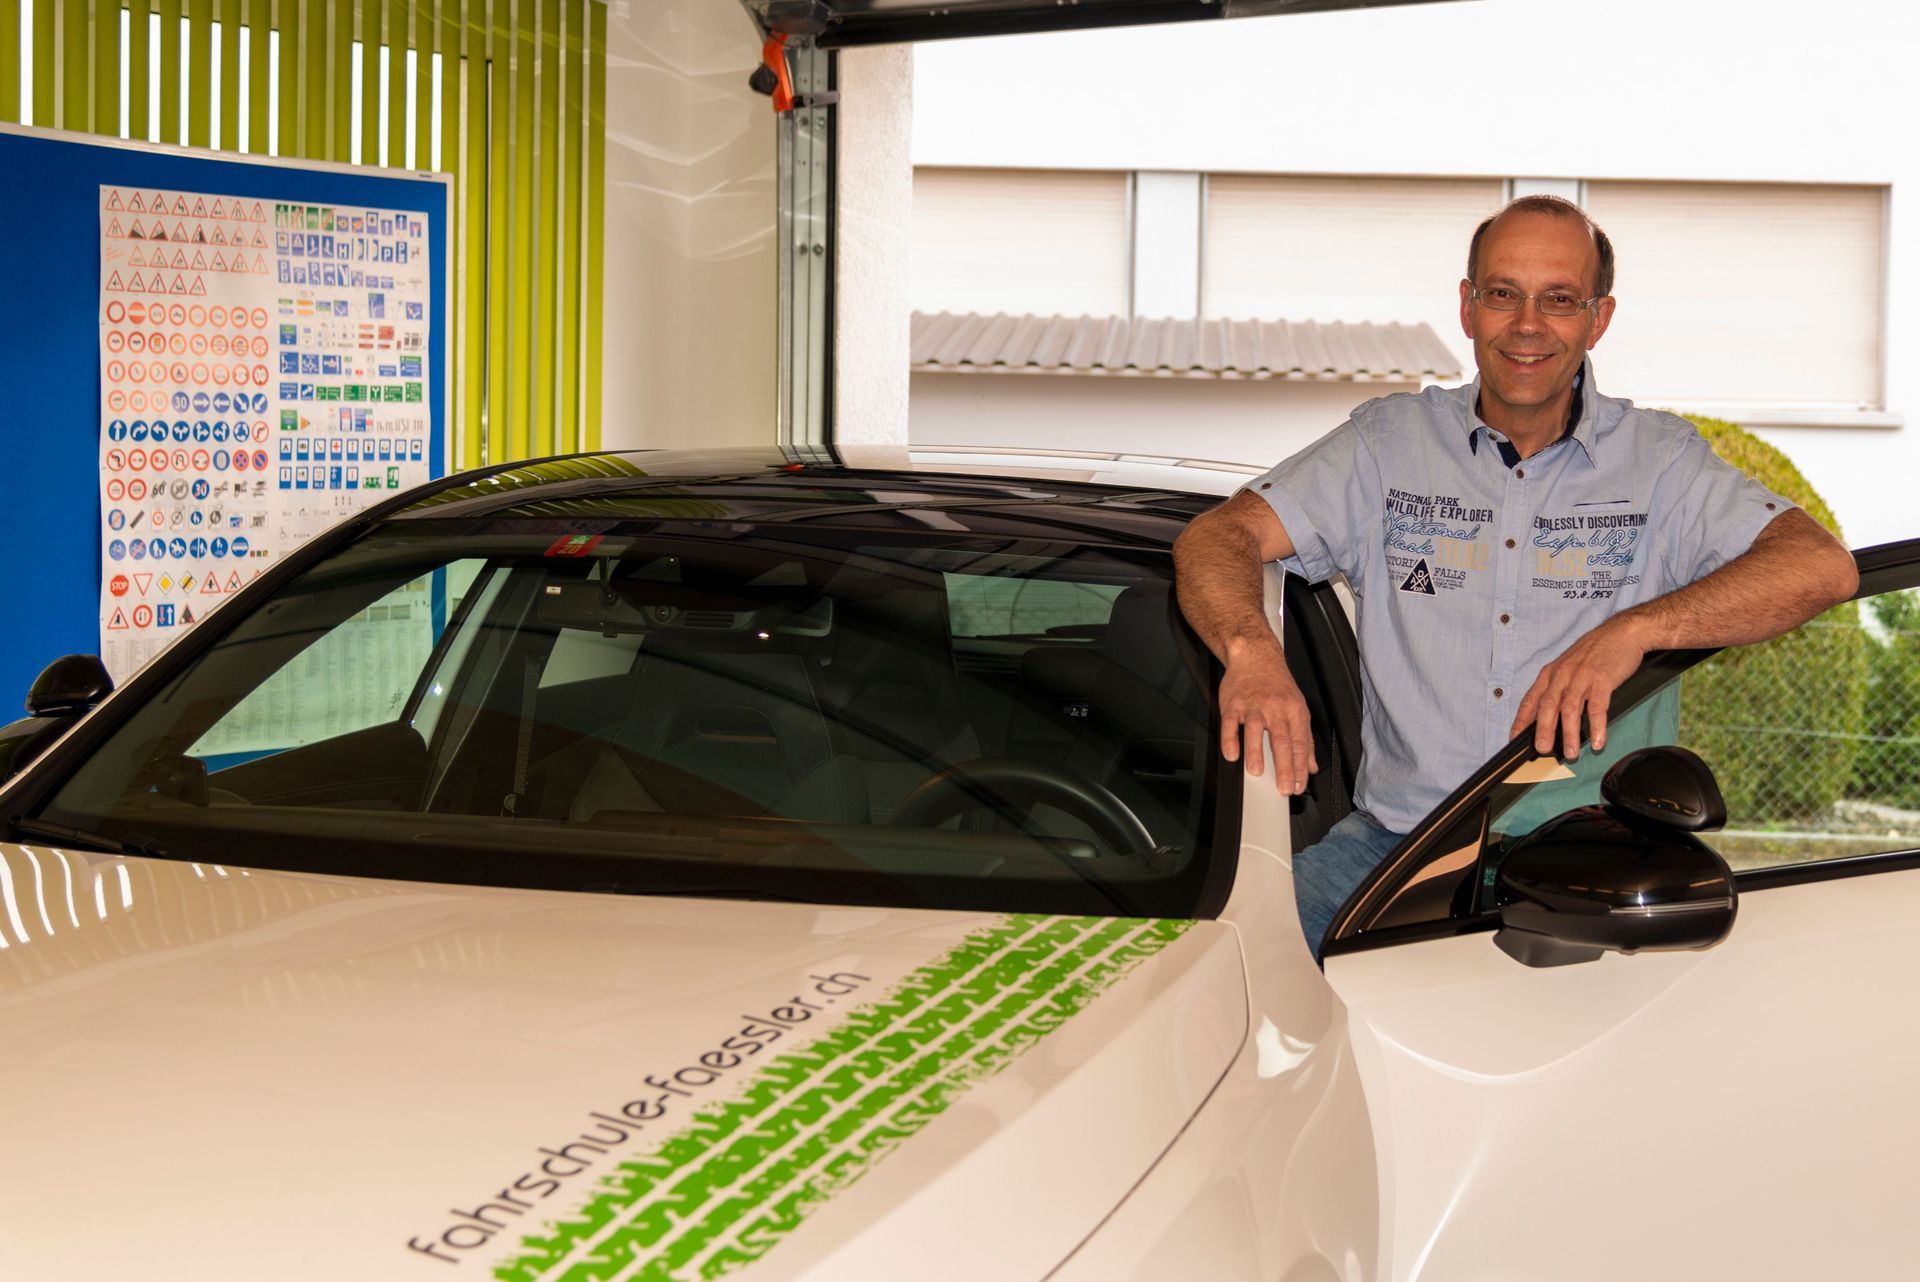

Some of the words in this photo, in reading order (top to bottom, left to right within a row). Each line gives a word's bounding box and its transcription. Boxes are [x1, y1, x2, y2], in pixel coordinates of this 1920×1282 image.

[339, 245, 349, 259] H
[384, 248, 391, 261] P
[174, 396, 188, 410] 30
[1388, 488, 1431, 506] NATIONAL
[1434, 496, 1460, 507] PARK
[1386, 497, 1436, 518] WILDLIFE
[1440, 506, 1493, 523] EXPLORER
[1382, 507, 1480, 540] National
[1533, 515, 1585, 531] ENDLESSLY
[1383, 528, 1435, 555] Park
[1433, 567, 1466, 581] FALLS
[1591, 571, 1612, 580] THE
[111, 582, 128, 591] STOP
[1532, 578, 1573, 589] ESSENCE
[1575, 580, 1589, 589] OF
[406, 969, 872, 1265] fahrschule-faessler.ch
